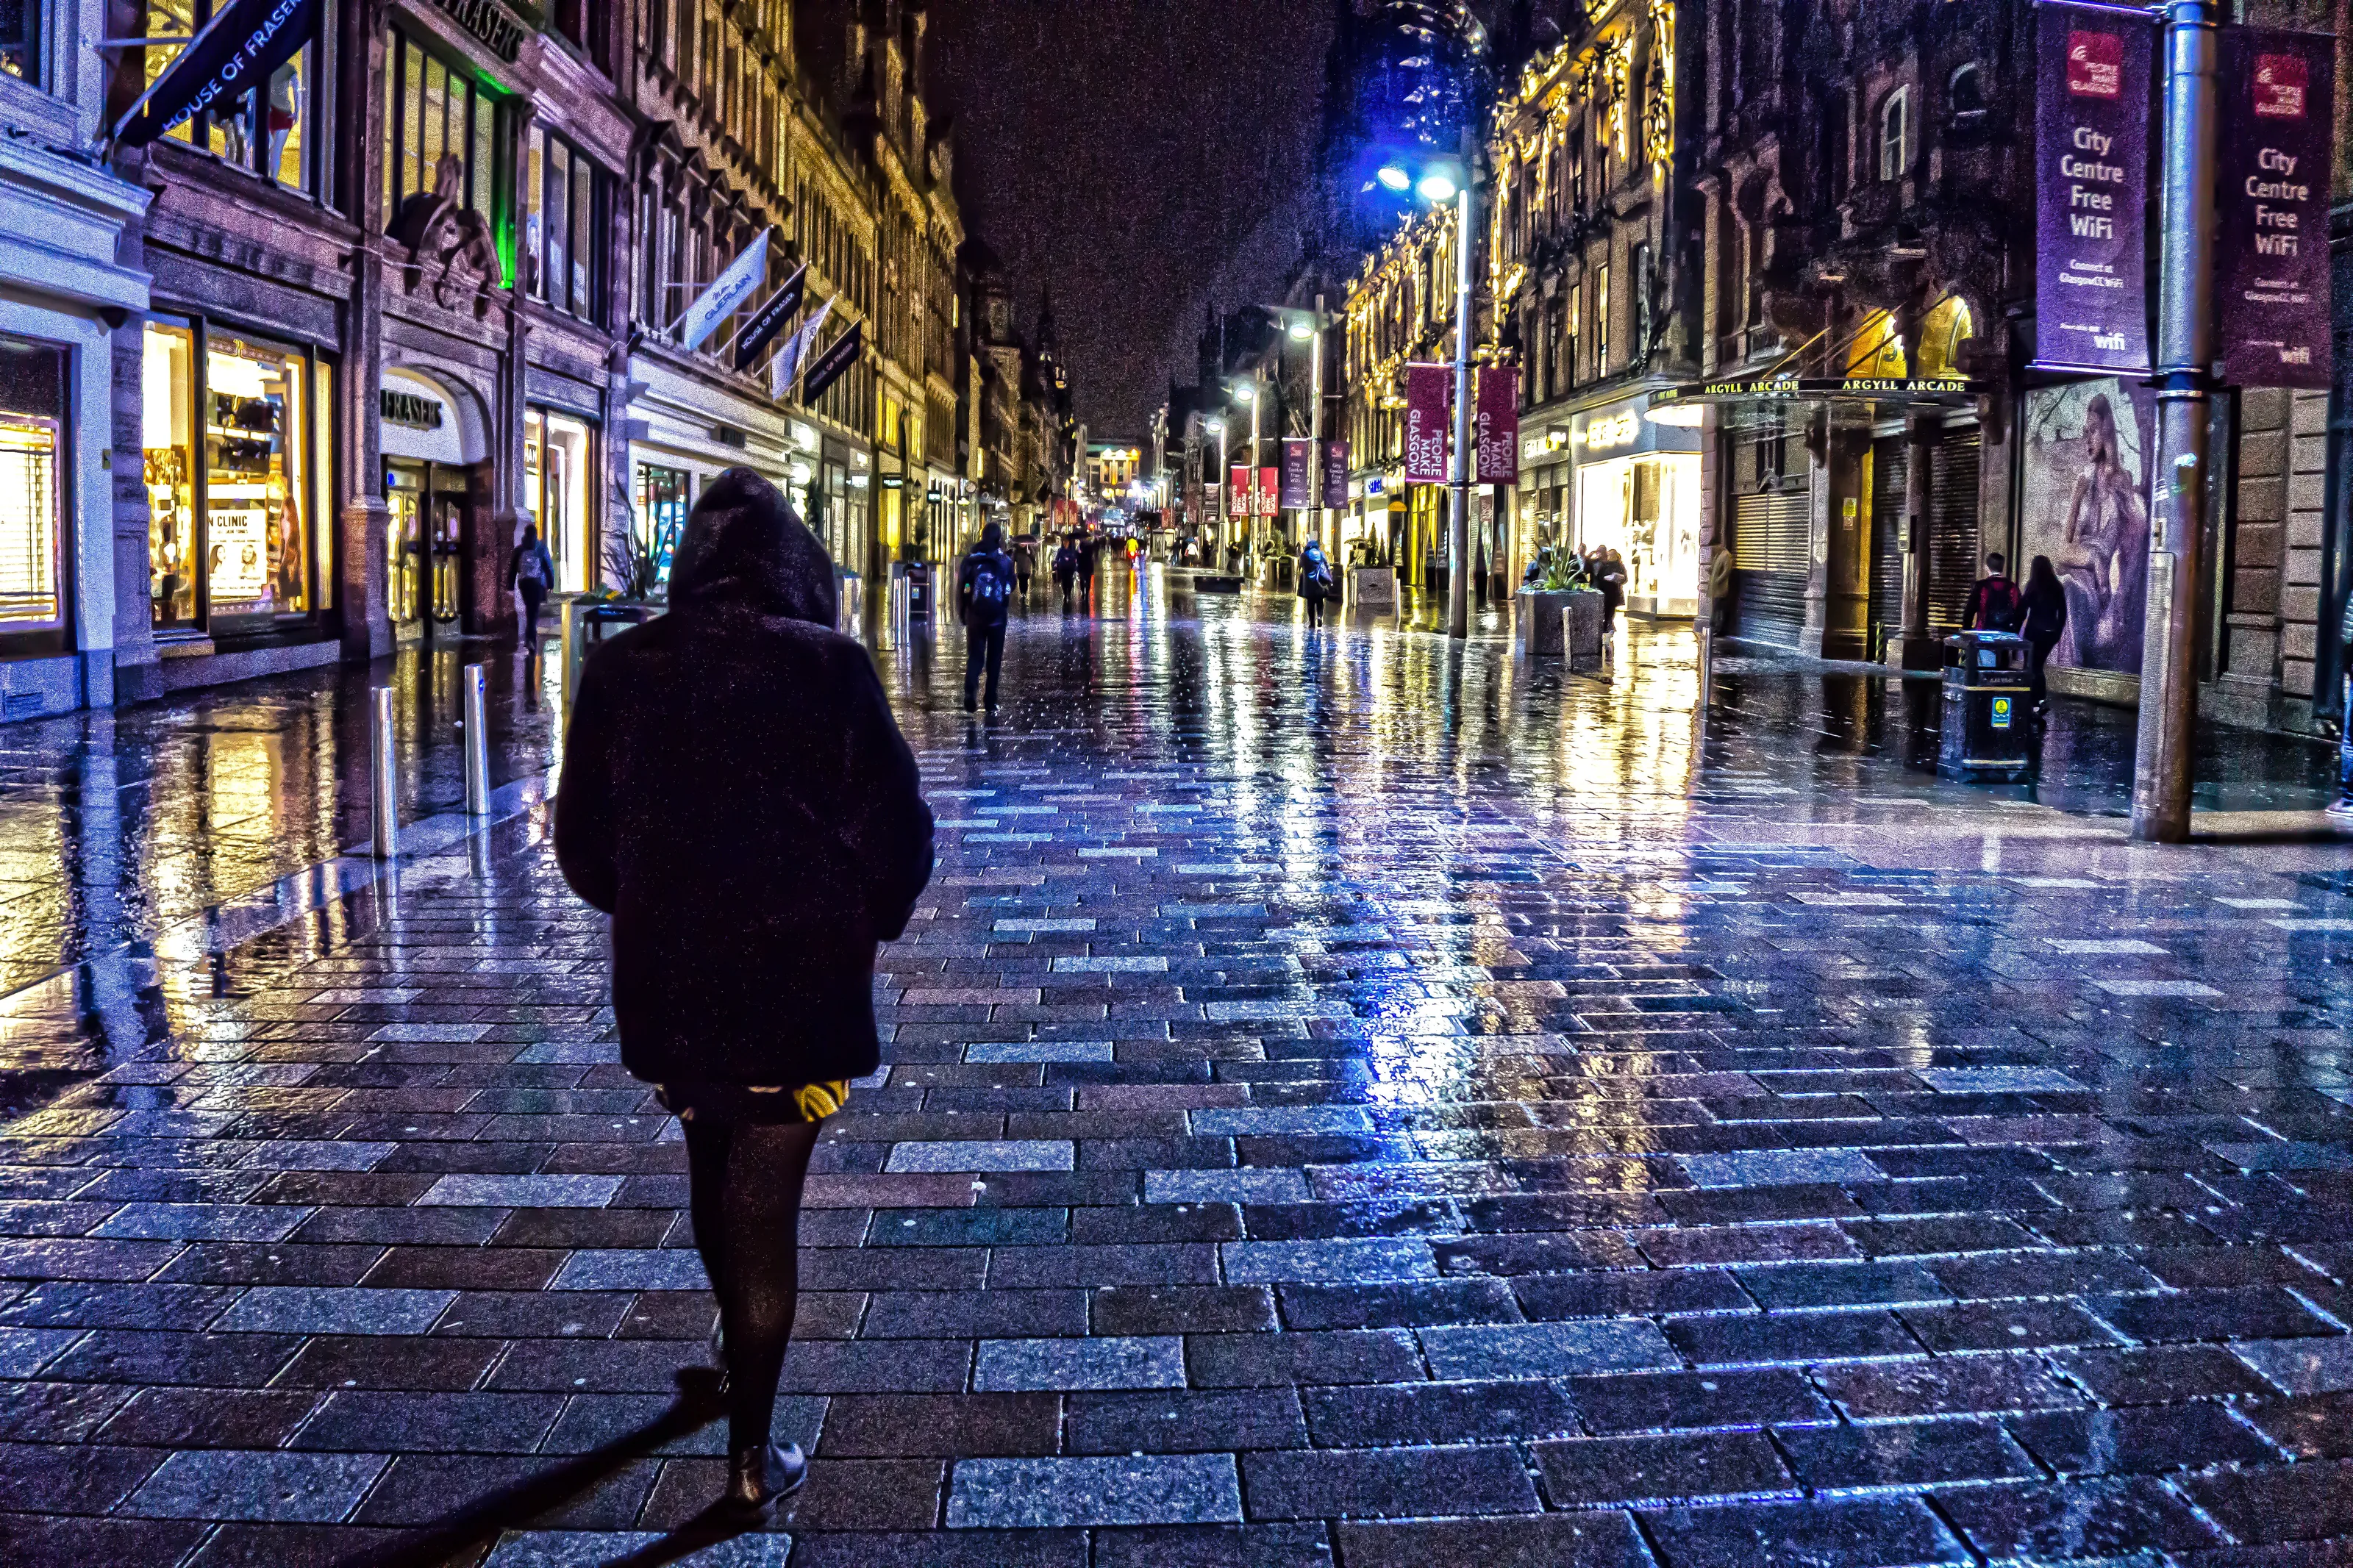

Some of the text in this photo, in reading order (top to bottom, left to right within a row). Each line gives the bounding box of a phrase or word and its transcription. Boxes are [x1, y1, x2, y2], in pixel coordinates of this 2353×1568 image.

[163, 78, 223, 131] HOUSE
[221, 51, 244, 80] OF
[2074, 126, 2113, 156] City
[2060, 154, 2125, 183] Centre
[2258, 147, 2298, 176] City
[2071, 185, 2113, 210] Free
[2246, 176, 2309, 201] Centre
[2070, 213, 2113, 239] WiFi
[2256, 204, 2298, 228] Free
[2255, 233, 2298, 256] WiFi
[704, 273, 751, 321] GUERLAIN
[741, 326, 763, 349] HOUSE
[762, 315, 771, 326] OF
[1704, 381, 1799, 395] ARGYLL ARCADE
[1842, 380, 1965, 392] ARGYLL ARCADE
[1408, 409, 1421, 476] GLASGOW
[1431, 429, 1443, 476] PEOPLE
[1479, 412, 1490, 478] GLASGOW
[1502, 432, 1513, 478] PEOPLE
[1419, 439, 1431, 476] MAKE
[1490, 441, 1502, 478] MAKE
[217, 516, 248, 527] CLINIC
